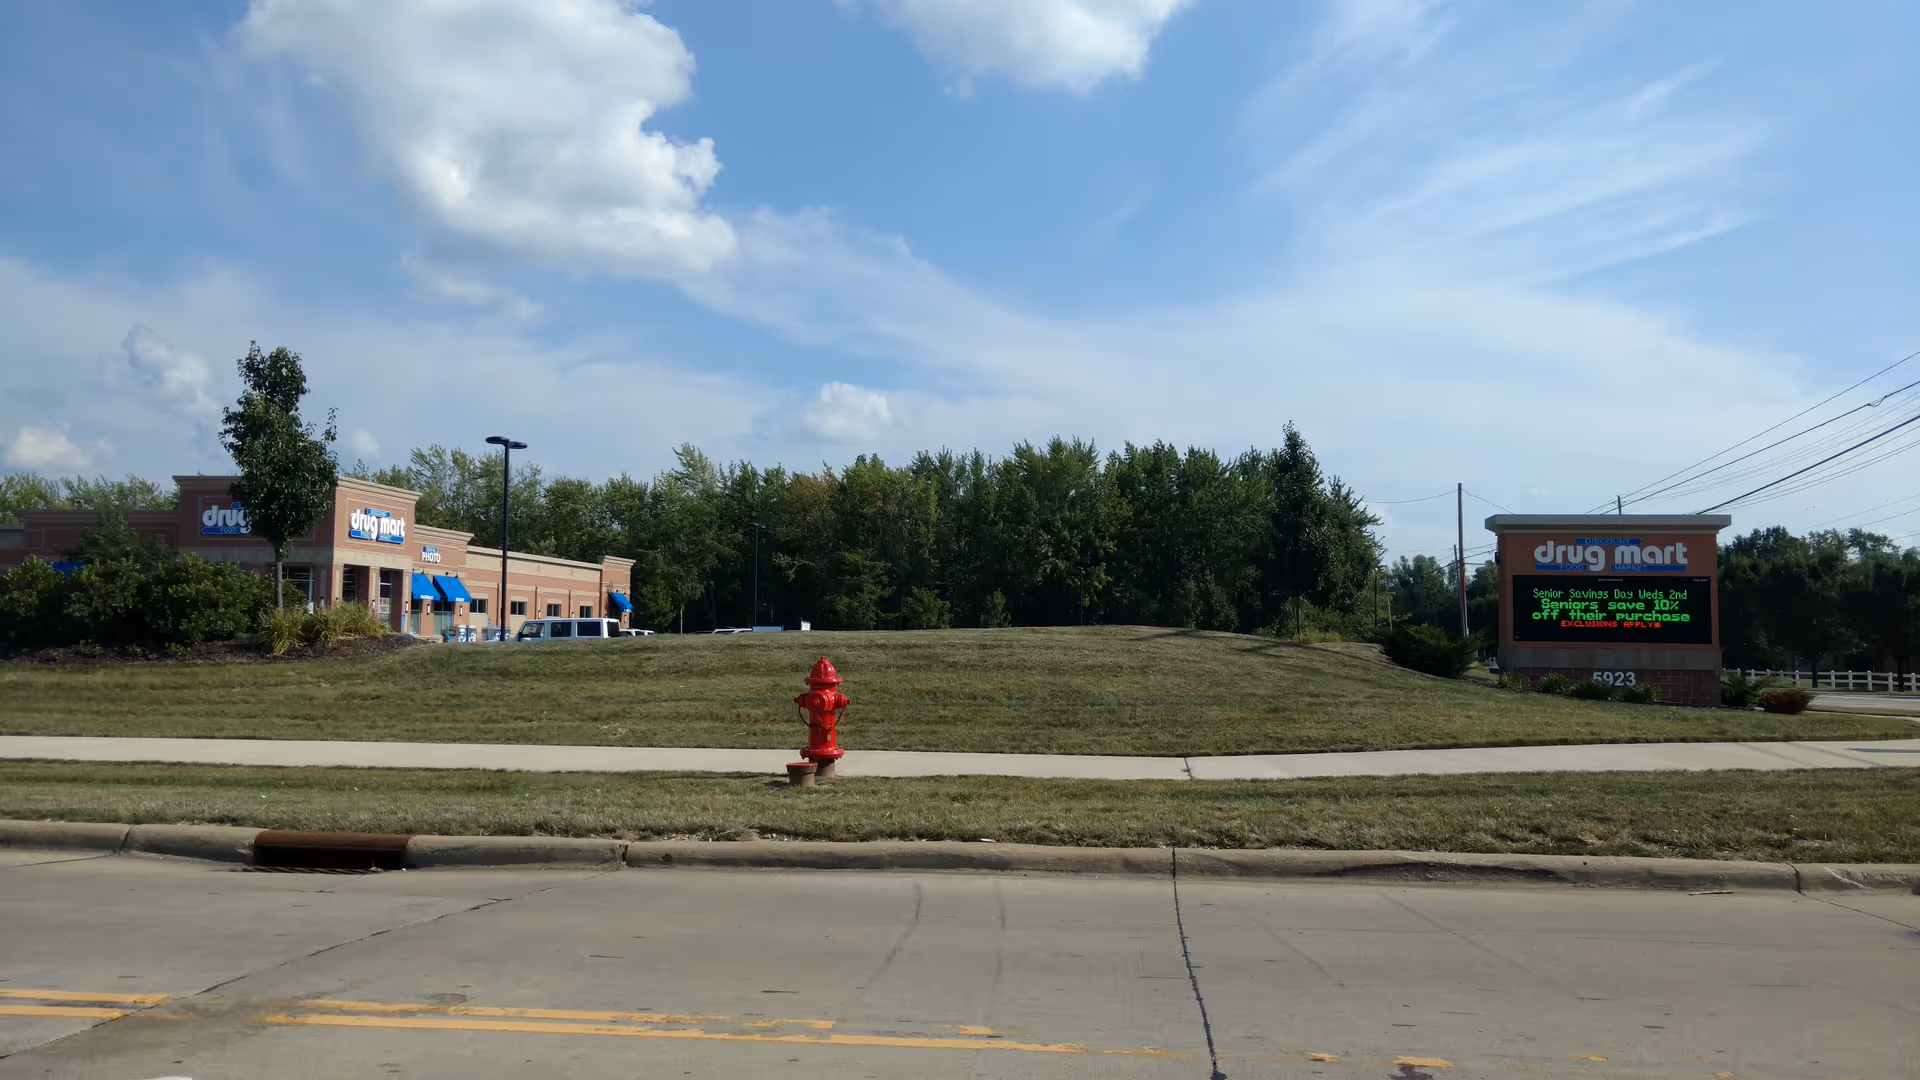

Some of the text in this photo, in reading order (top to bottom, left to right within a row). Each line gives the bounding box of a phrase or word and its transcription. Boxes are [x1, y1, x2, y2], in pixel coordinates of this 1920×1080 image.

[351, 508, 406, 540] drug mart
[421, 551, 441, 563] PHOTO
[1533, 540, 1688, 572] drug mart
[1533, 588, 1688, 600] Senior Savings Day Weds 2nd
[1541, 598, 1680, 611] Seniors save 10%
[1532, 610, 1690, 622] off their purchase
[1560, 620, 1618, 628] EXCLUSIONS
[1592, 671, 1636, 687] 5923
